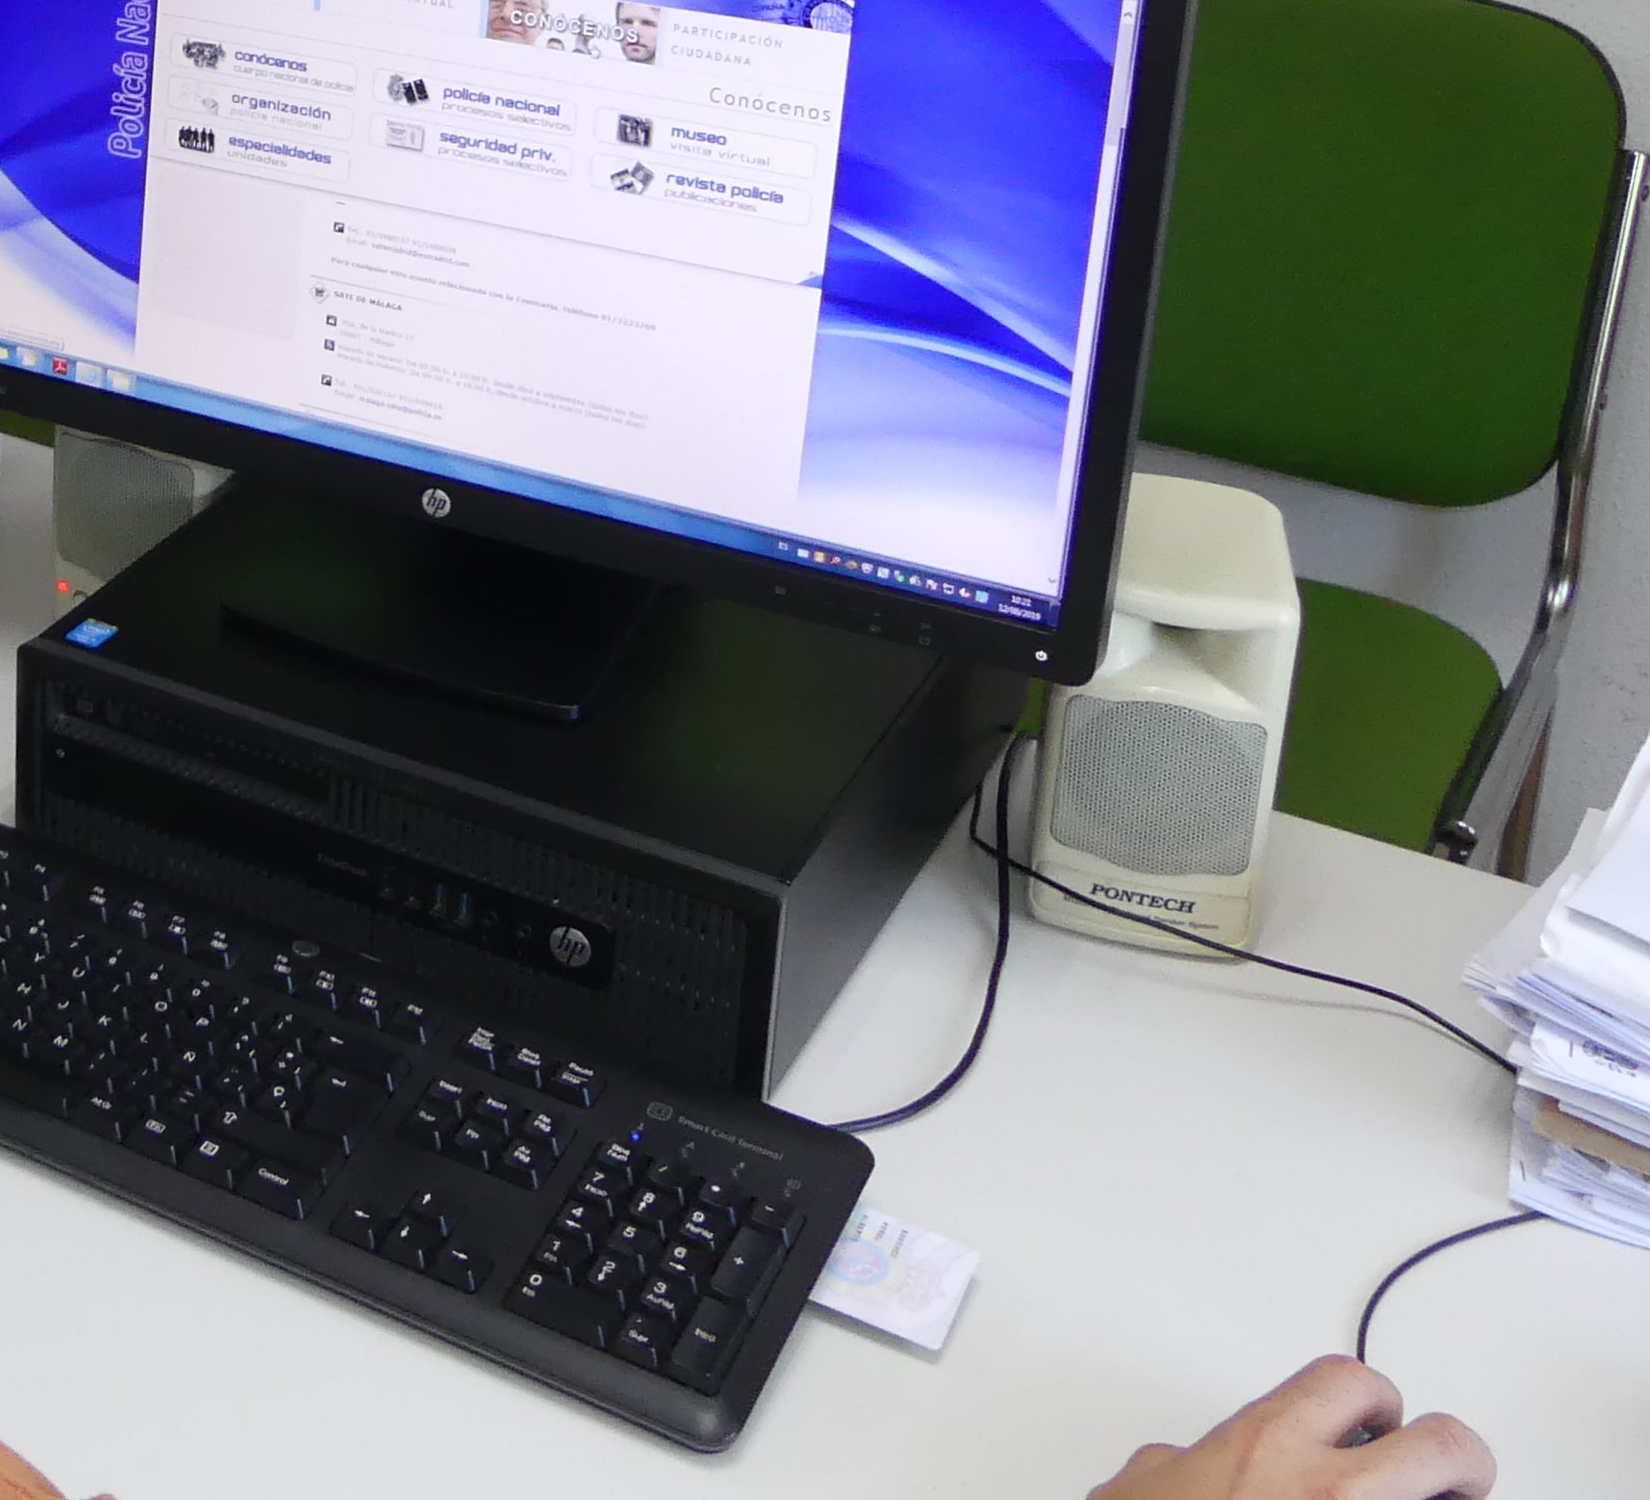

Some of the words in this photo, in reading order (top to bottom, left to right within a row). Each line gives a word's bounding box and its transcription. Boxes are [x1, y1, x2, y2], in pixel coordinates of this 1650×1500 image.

[510, 8, 640, 44] CONÓCENOS
[673, 23, 783, 49] PARTICIPACIÓN
[234, 50, 307, 73] conócenos
[670, 45, 752, 66] CIUDADANA
[231, 93, 331, 121] organización
[441, 101, 504, 120] procesos
[507, 111, 573, 132] selectivos
[495, 94, 561, 117] nacional
[709, 87, 832, 122] Conócenos
[440, 131, 517, 155] seguridad
[671, 126, 727, 146] museo
[227, 149, 288, 168] unidades
[228, 135, 332, 164] especialidades
[438, 146, 500, 165] procesos
[503, 157, 568, 177] selectivos
[670, 142, 712, 157] visita
[717, 150, 771, 167] virtual
[666, 173, 726, 194] revista
[423, 488, 450, 517] hp
[1090, 882, 1197, 914] PONTECH
[552, 926, 591, 968] hp
[258, 1167, 290, 1186] Control
